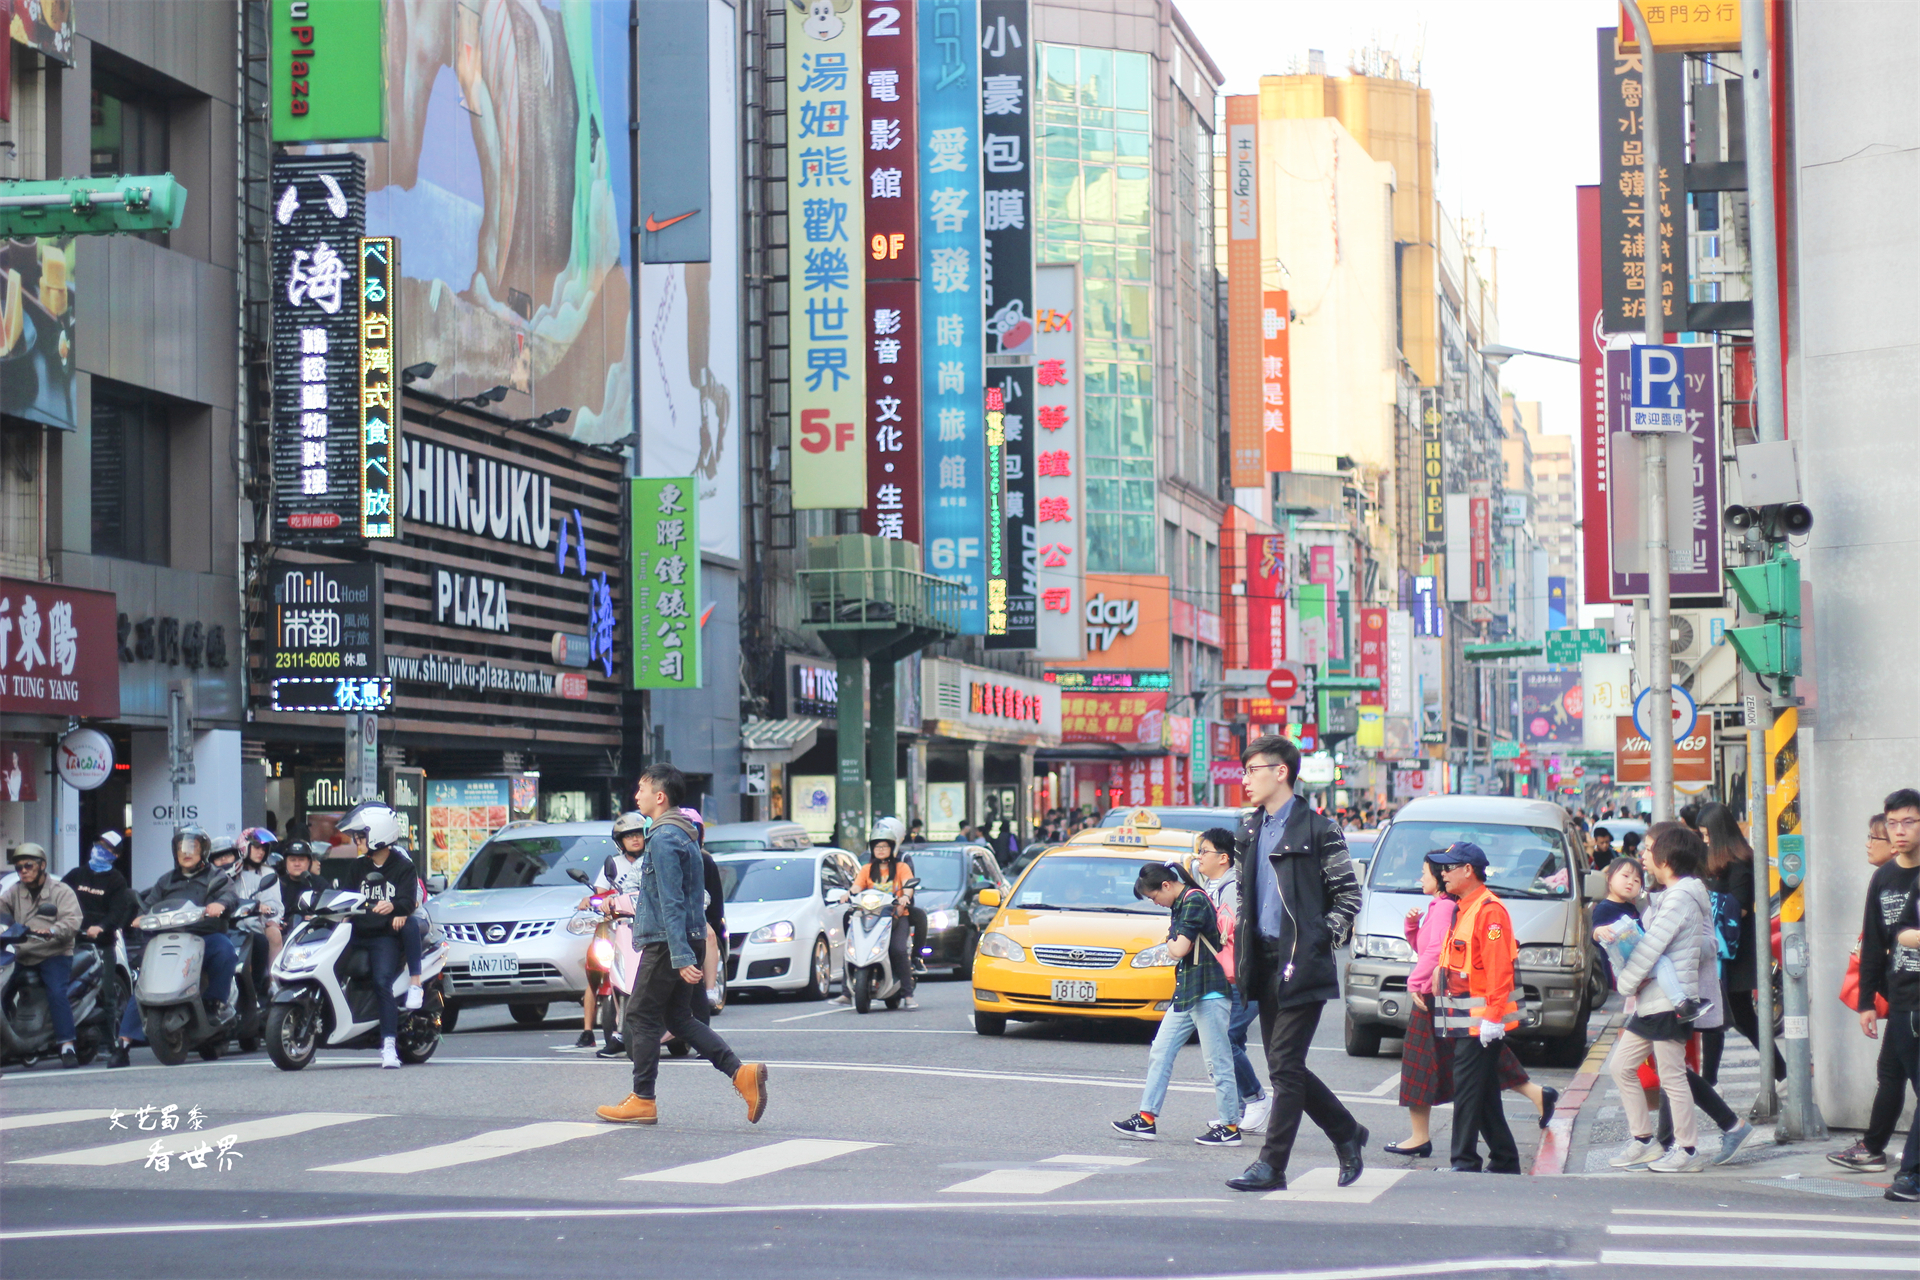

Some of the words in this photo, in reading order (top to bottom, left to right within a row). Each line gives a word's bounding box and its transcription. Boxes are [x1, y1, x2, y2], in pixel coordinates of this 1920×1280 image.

[1647, 4, 1735, 23] 西門分行
[291, 26, 314, 116] Plaza
[868, 70, 901, 198] 電影館
[982, 16, 1024, 231] 小豪包膜
[1233, 139, 1253, 197] Holiday
[276, 174, 349, 314] 八海
[797, 52, 851, 392] 湯姆熊歡樂世界
[871, 234, 904, 260] 9F
[928, 127, 970, 490] 愛客發時尚旅館
[1263, 355, 1285, 433] 康是美
[1641, 349, 1677, 405] P
[800, 409, 854, 453] 5F
[1634, 412, 1683, 426] 歡迎臨停
[402, 437, 551, 549] SHINJUKU
[1425, 442, 1442, 532] HOTEL
[931, 538, 979, 568] 6F
[283, 608, 341, 648] 米勒
[438, 570, 509, 632] PLAZA
[12, 675, 45, 699] TUNG
[48, 678, 78, 702] YANG
[275, 652, 341, 669] 2311-6006
[343, 653, 368, 667] 休息
[334, 680, 383, 708] 休息
[1745, 696, 1757, 725] ZEMOK
